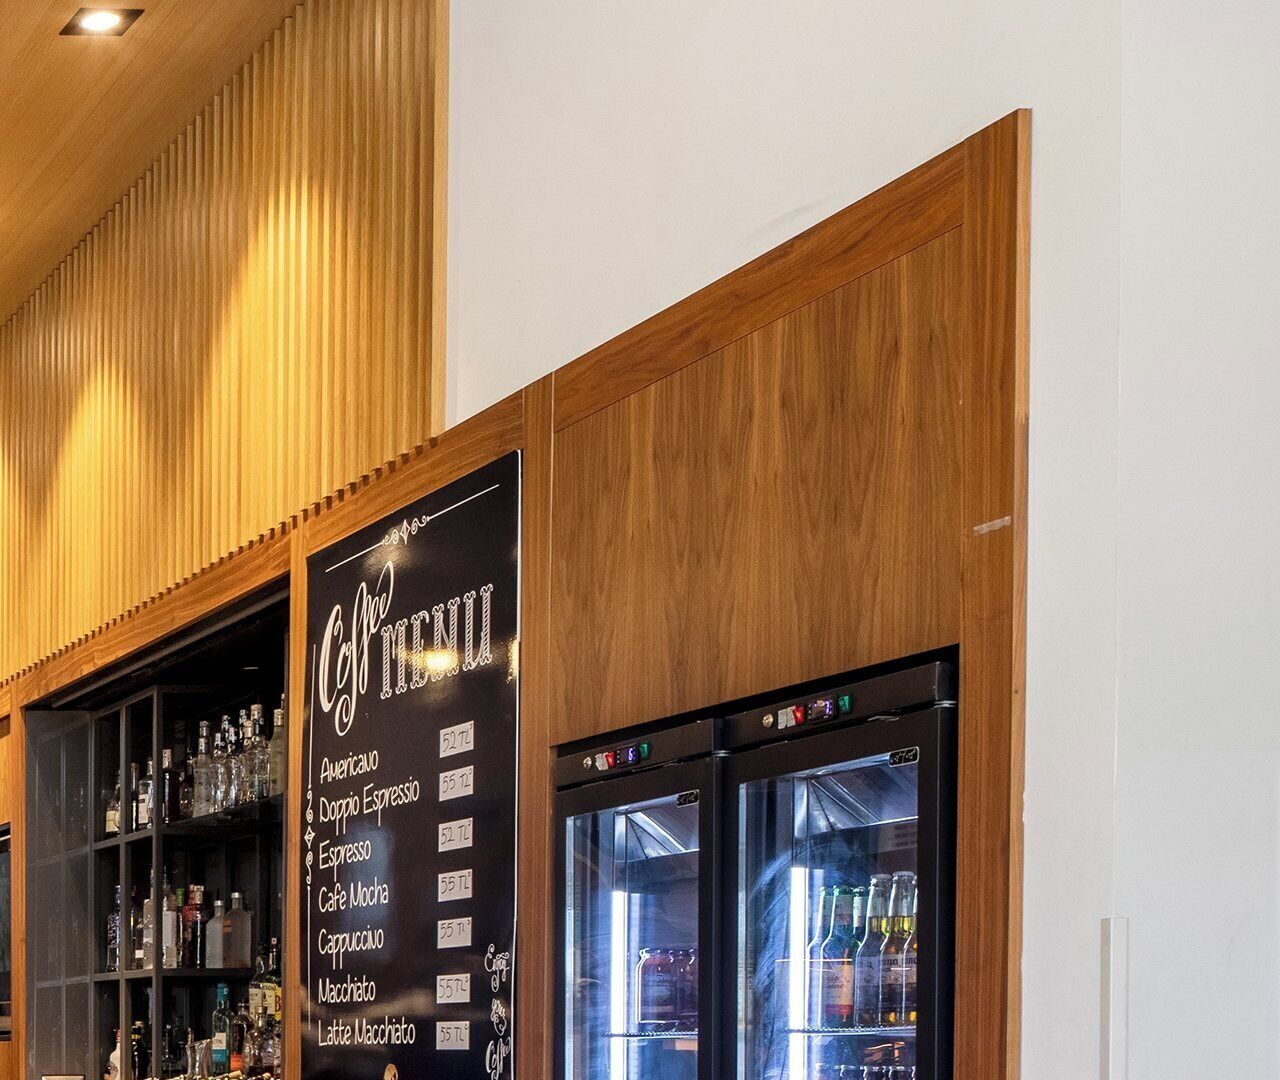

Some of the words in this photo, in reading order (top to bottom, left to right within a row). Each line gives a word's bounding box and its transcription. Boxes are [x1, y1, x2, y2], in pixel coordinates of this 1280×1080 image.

[318, 560, 395, 737] Coffee
[380, 583, 494, 700] MENU
[442, 731, 457, 753] 52
[320, 750, 379, 784] Americano
[442, 773, 456, 794] 55
[319, 791, 360, 837] Doppio
[363, 776, 420, 827] Espressio
[441, 826, 455, 846] 52
[319, 840, 372, 882] Espresso
[318, 882, 347, 913] Cafe
[349, 876, 389, 909] Mocha
[441, 876, 456, 895] 55
[440, 921, 455, 940] 55
[318, 925, 384, 970] Cappuccino
[318, 974, 376, 1004] Macchiato
[438, 978, 453, 999] 55
[318, 1019, 352, 1047] Latte
[354, 1015, 416, 1045] Macchiato
[440, 1026, 452, 1043] 55
